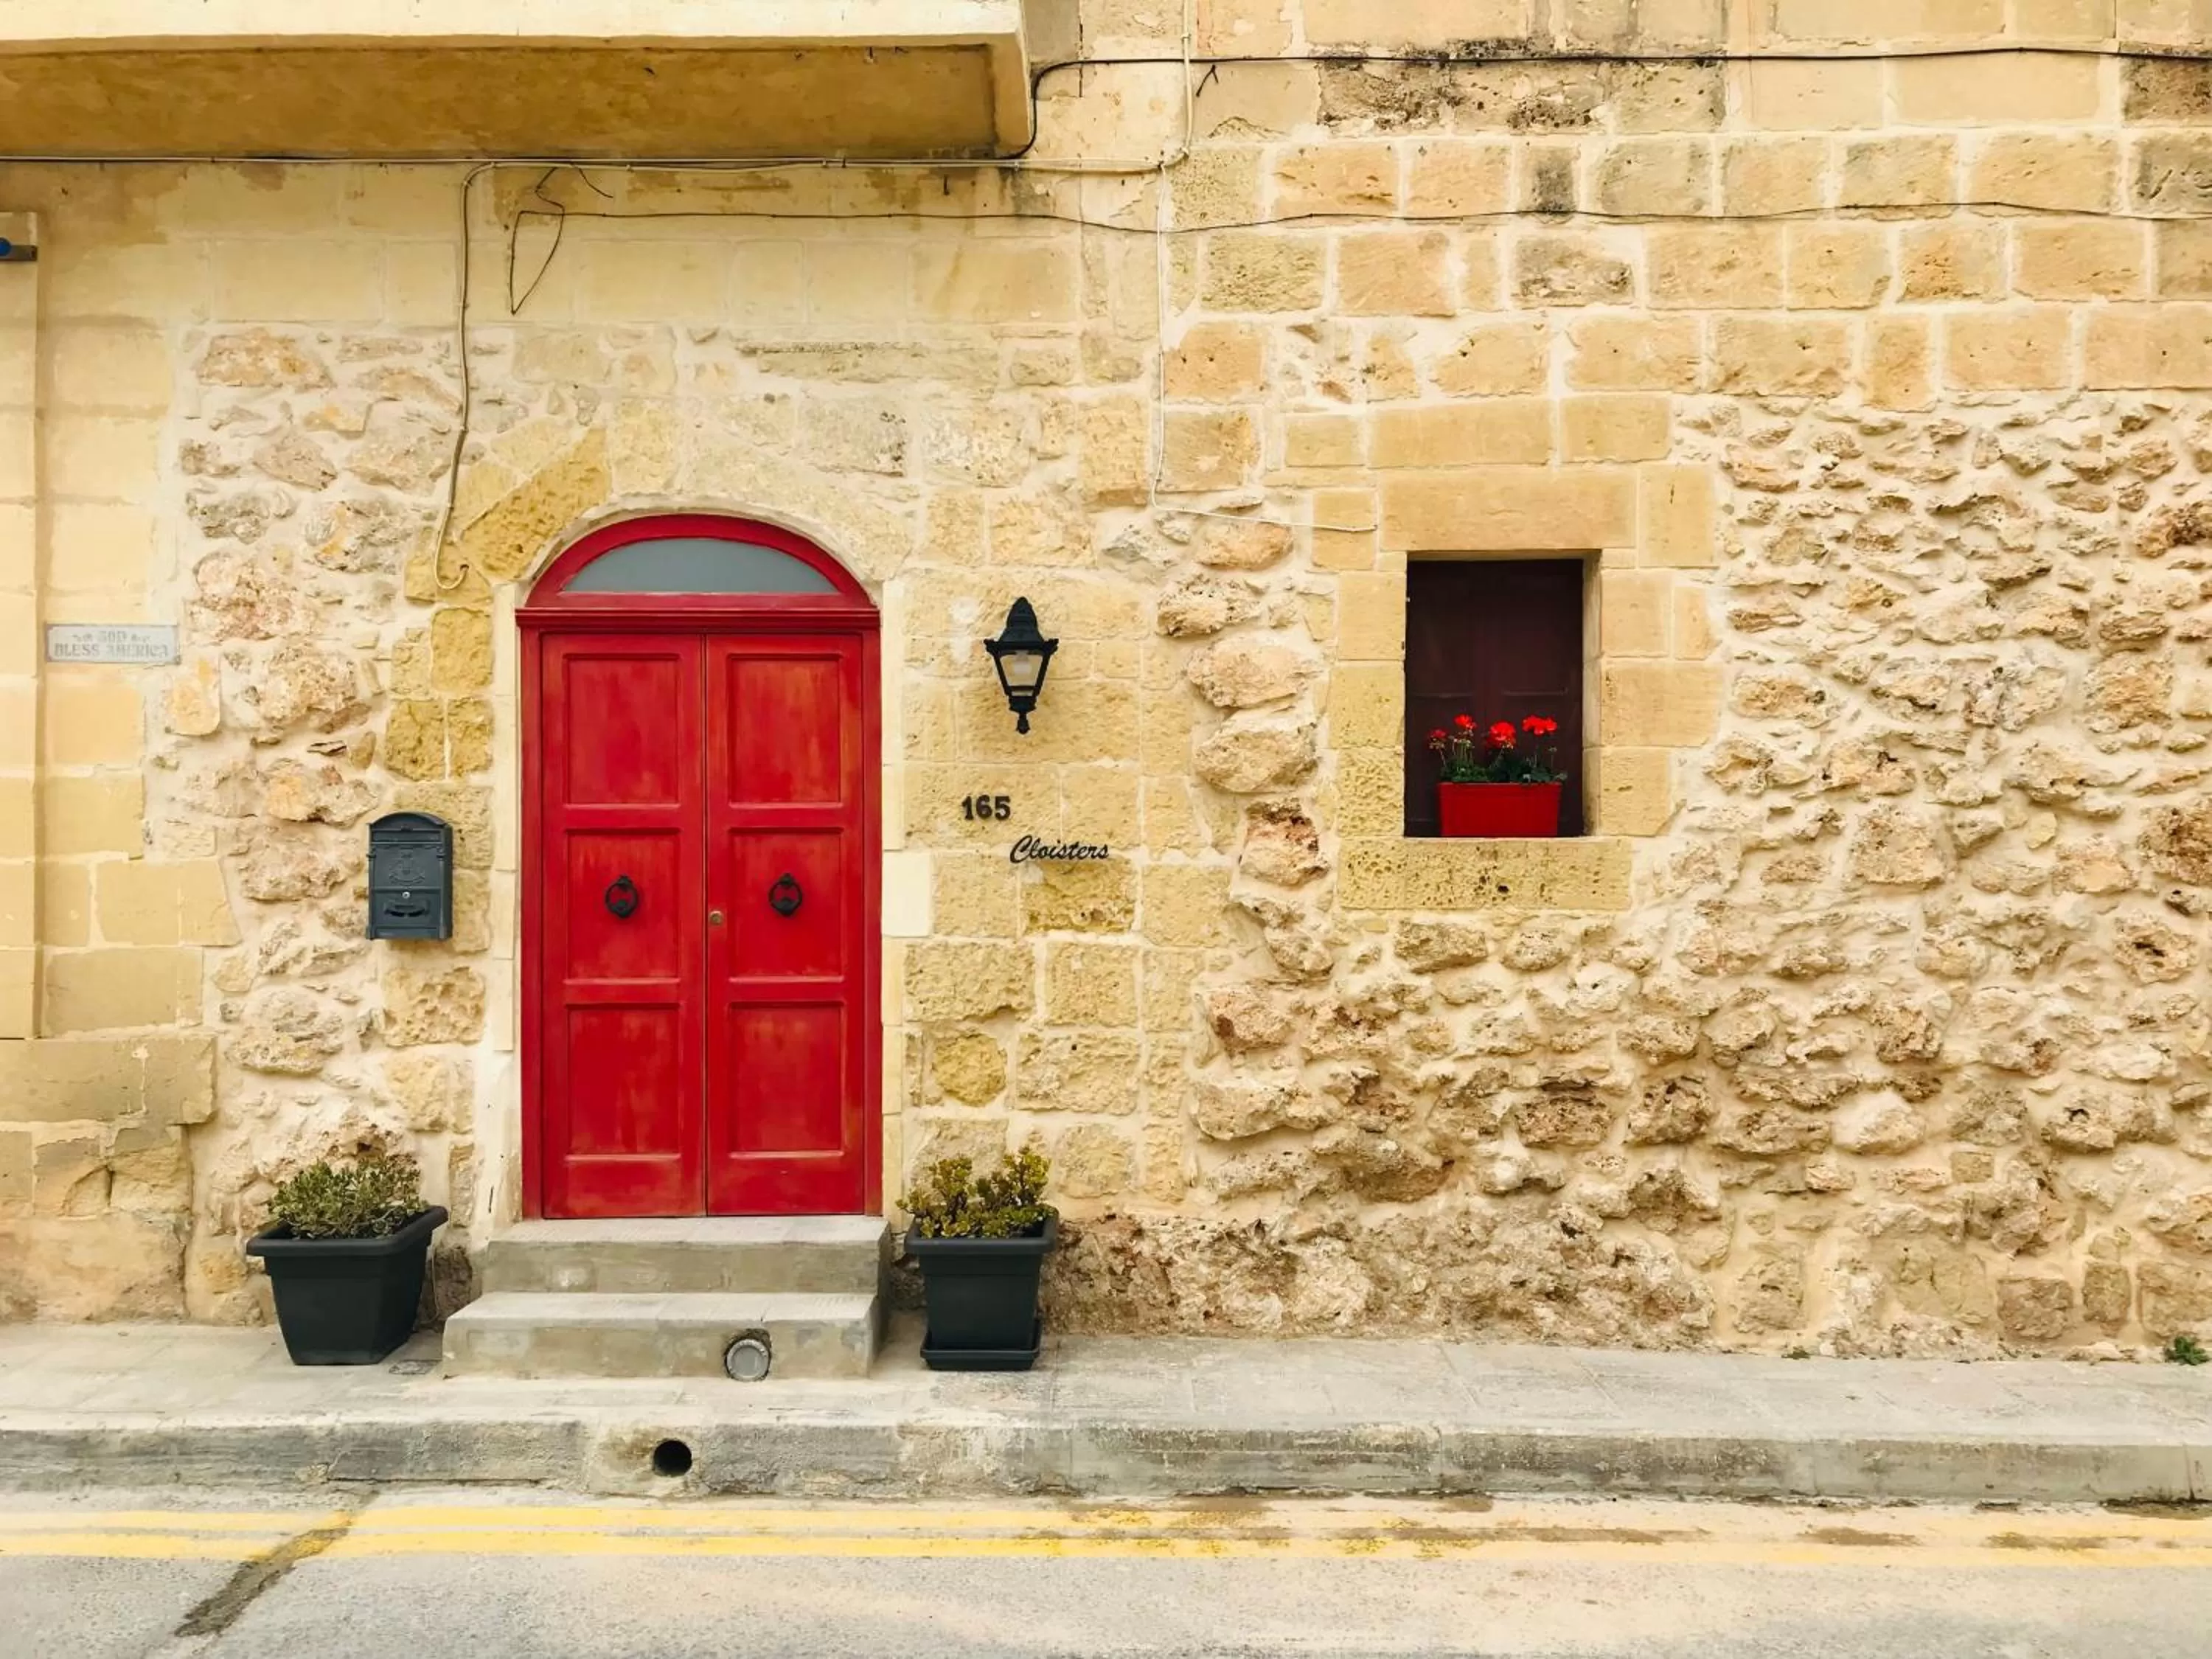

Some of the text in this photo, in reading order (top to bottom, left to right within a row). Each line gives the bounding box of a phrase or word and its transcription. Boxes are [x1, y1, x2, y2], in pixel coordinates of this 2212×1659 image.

[97, 630, 128, 642] GOD
[54, 643, 169, 658] BLESS AMERICA
[961, 795, 1011, 821] 165
[1009, 835, 1109, 863] Cloisters
